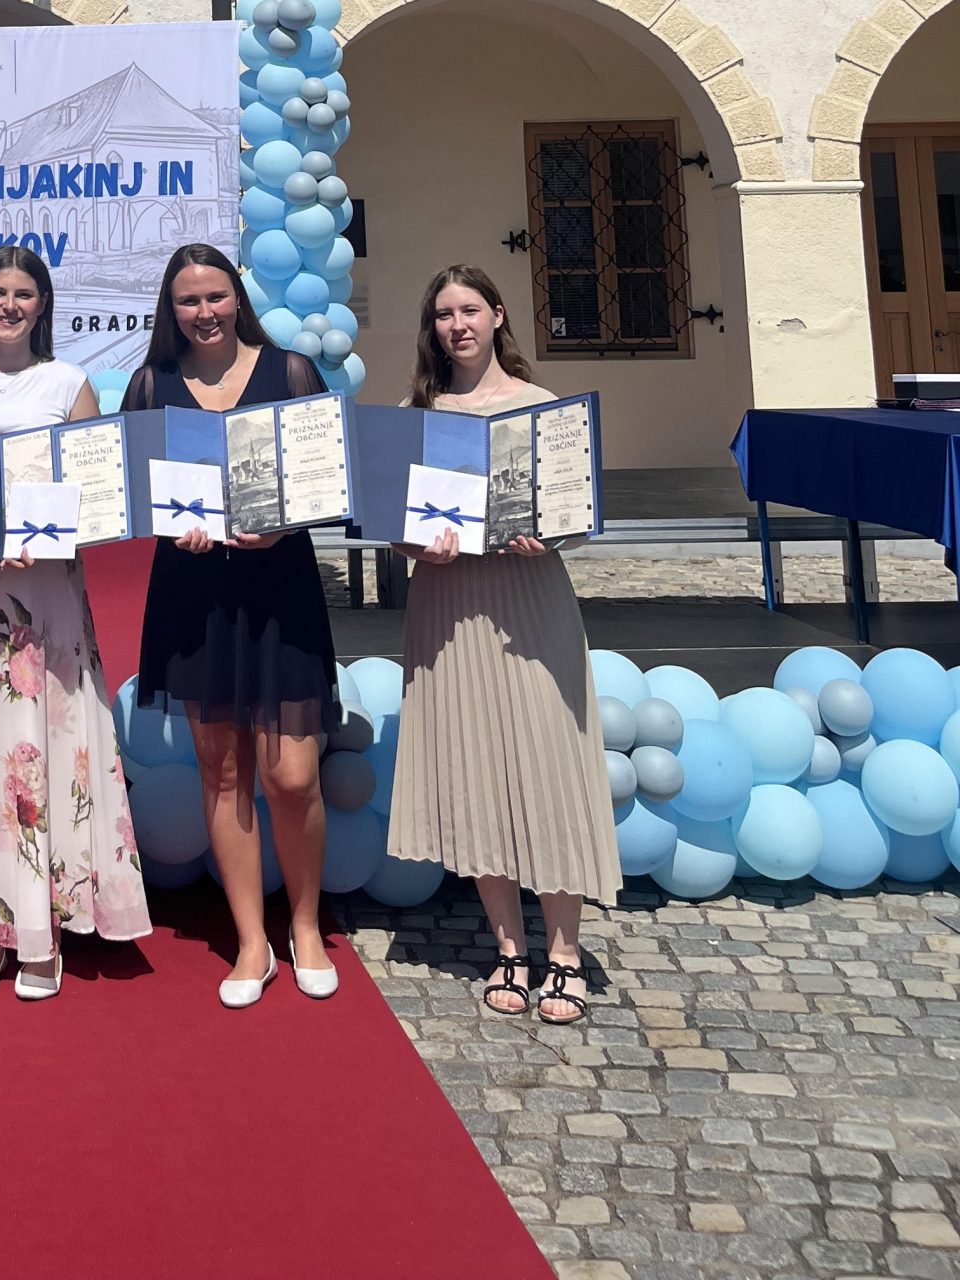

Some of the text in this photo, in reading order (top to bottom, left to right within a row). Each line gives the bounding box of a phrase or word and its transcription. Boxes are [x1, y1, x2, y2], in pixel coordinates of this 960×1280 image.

[158, 160, 194, 196] IN
[71, 314, 155, 333] GRADE
[288, 421, 334, 435] PRIZNANJE
[295, 431, 328, 443] OBČINE
[543, 429, 582, 444] PRIZNANJE
[549, 440, 576, 452] OBČINE
[69, 447, 113, 460] PRIZNANJE
[76, 456, 107, 467] OBČINE
